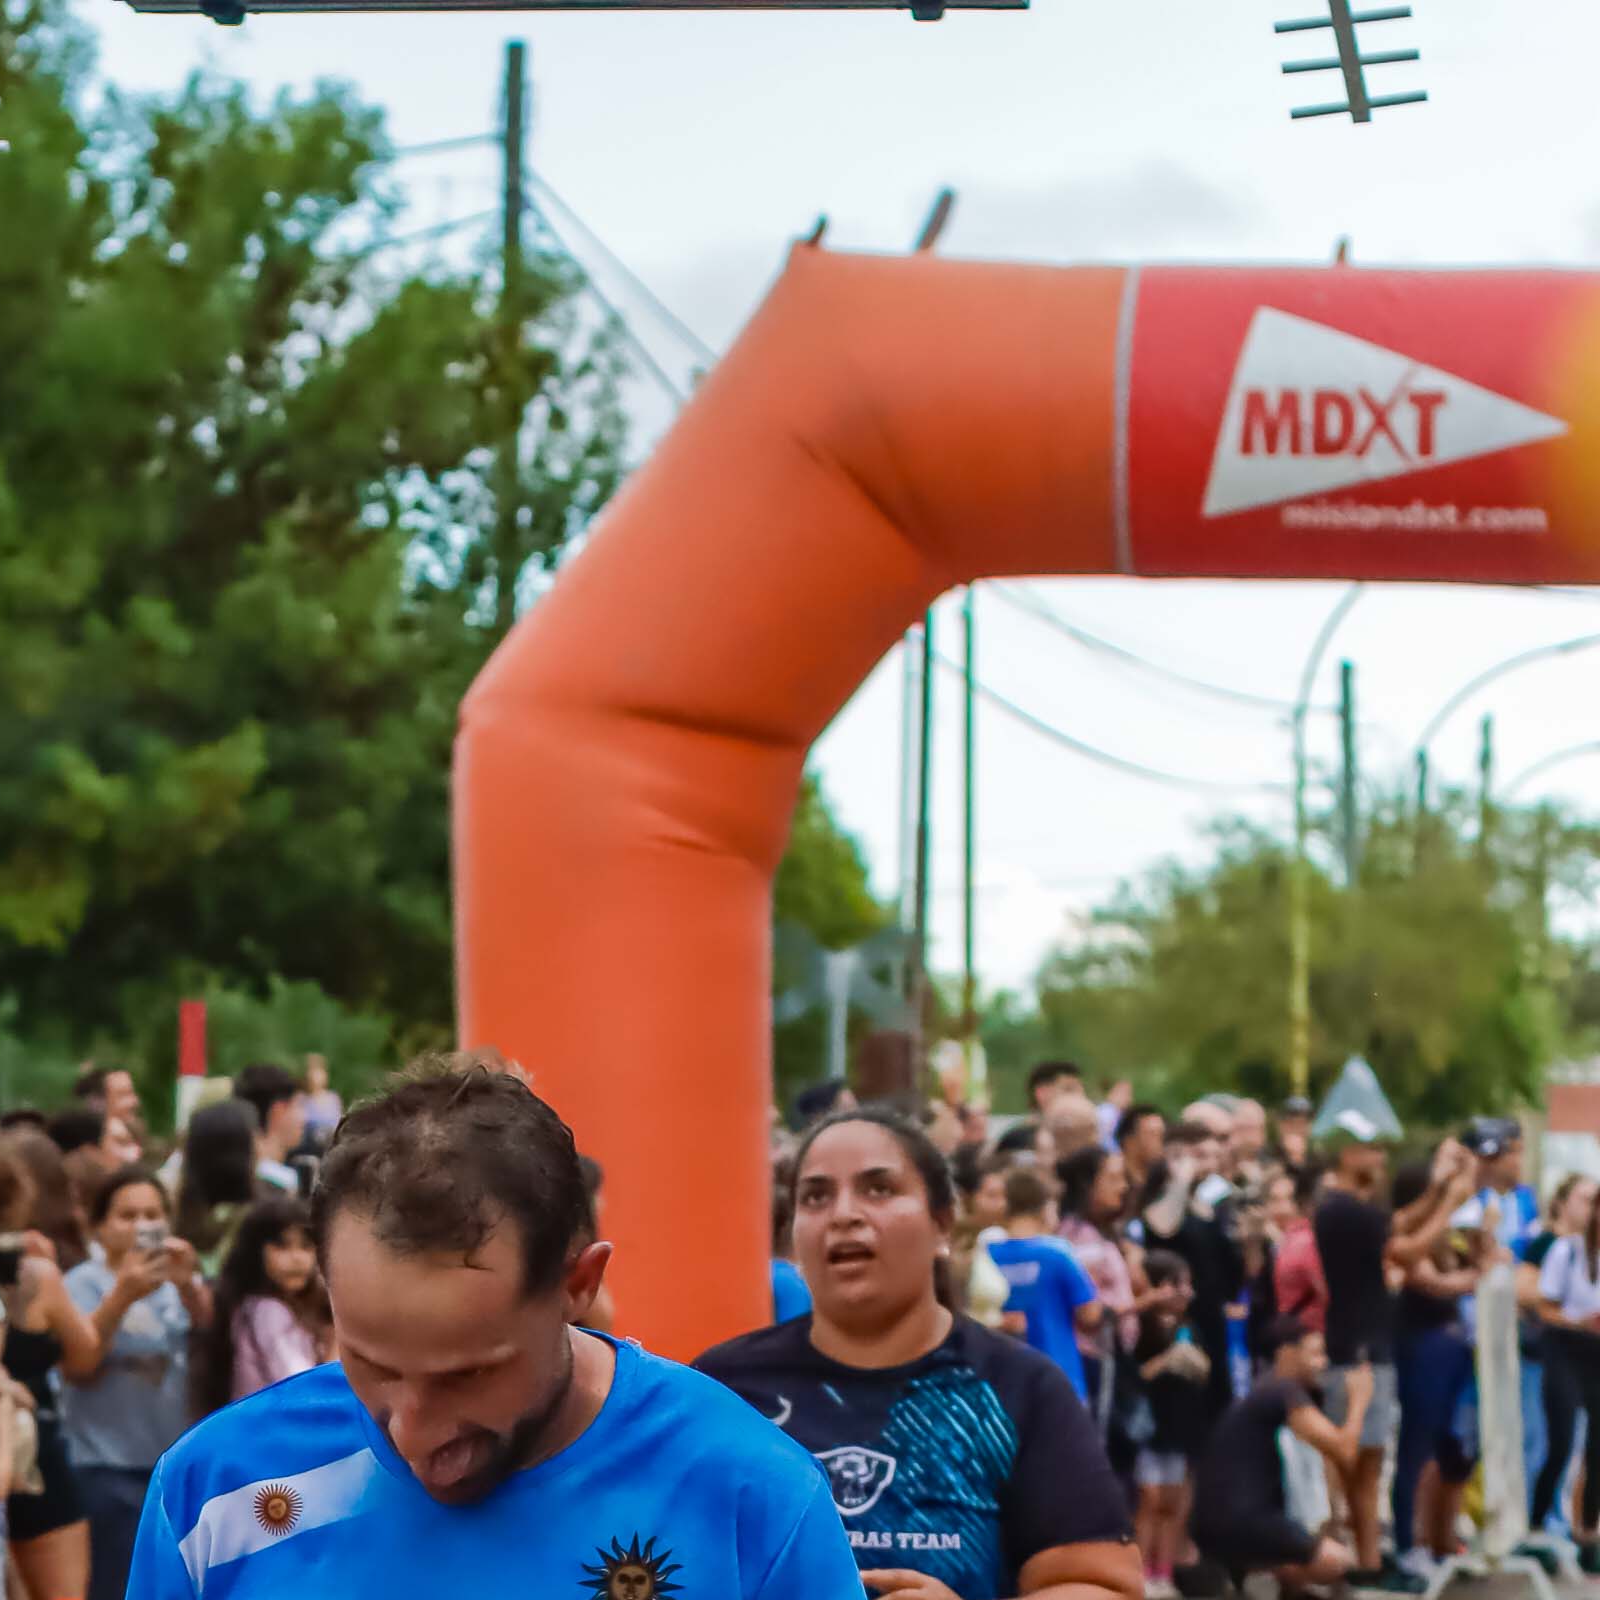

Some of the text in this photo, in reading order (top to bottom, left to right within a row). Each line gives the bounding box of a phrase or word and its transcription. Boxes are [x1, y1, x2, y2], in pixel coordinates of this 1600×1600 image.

[1239, 388, 1446, 459] MDXT
[849, 1531, 961, 1550] RAS TEAM
